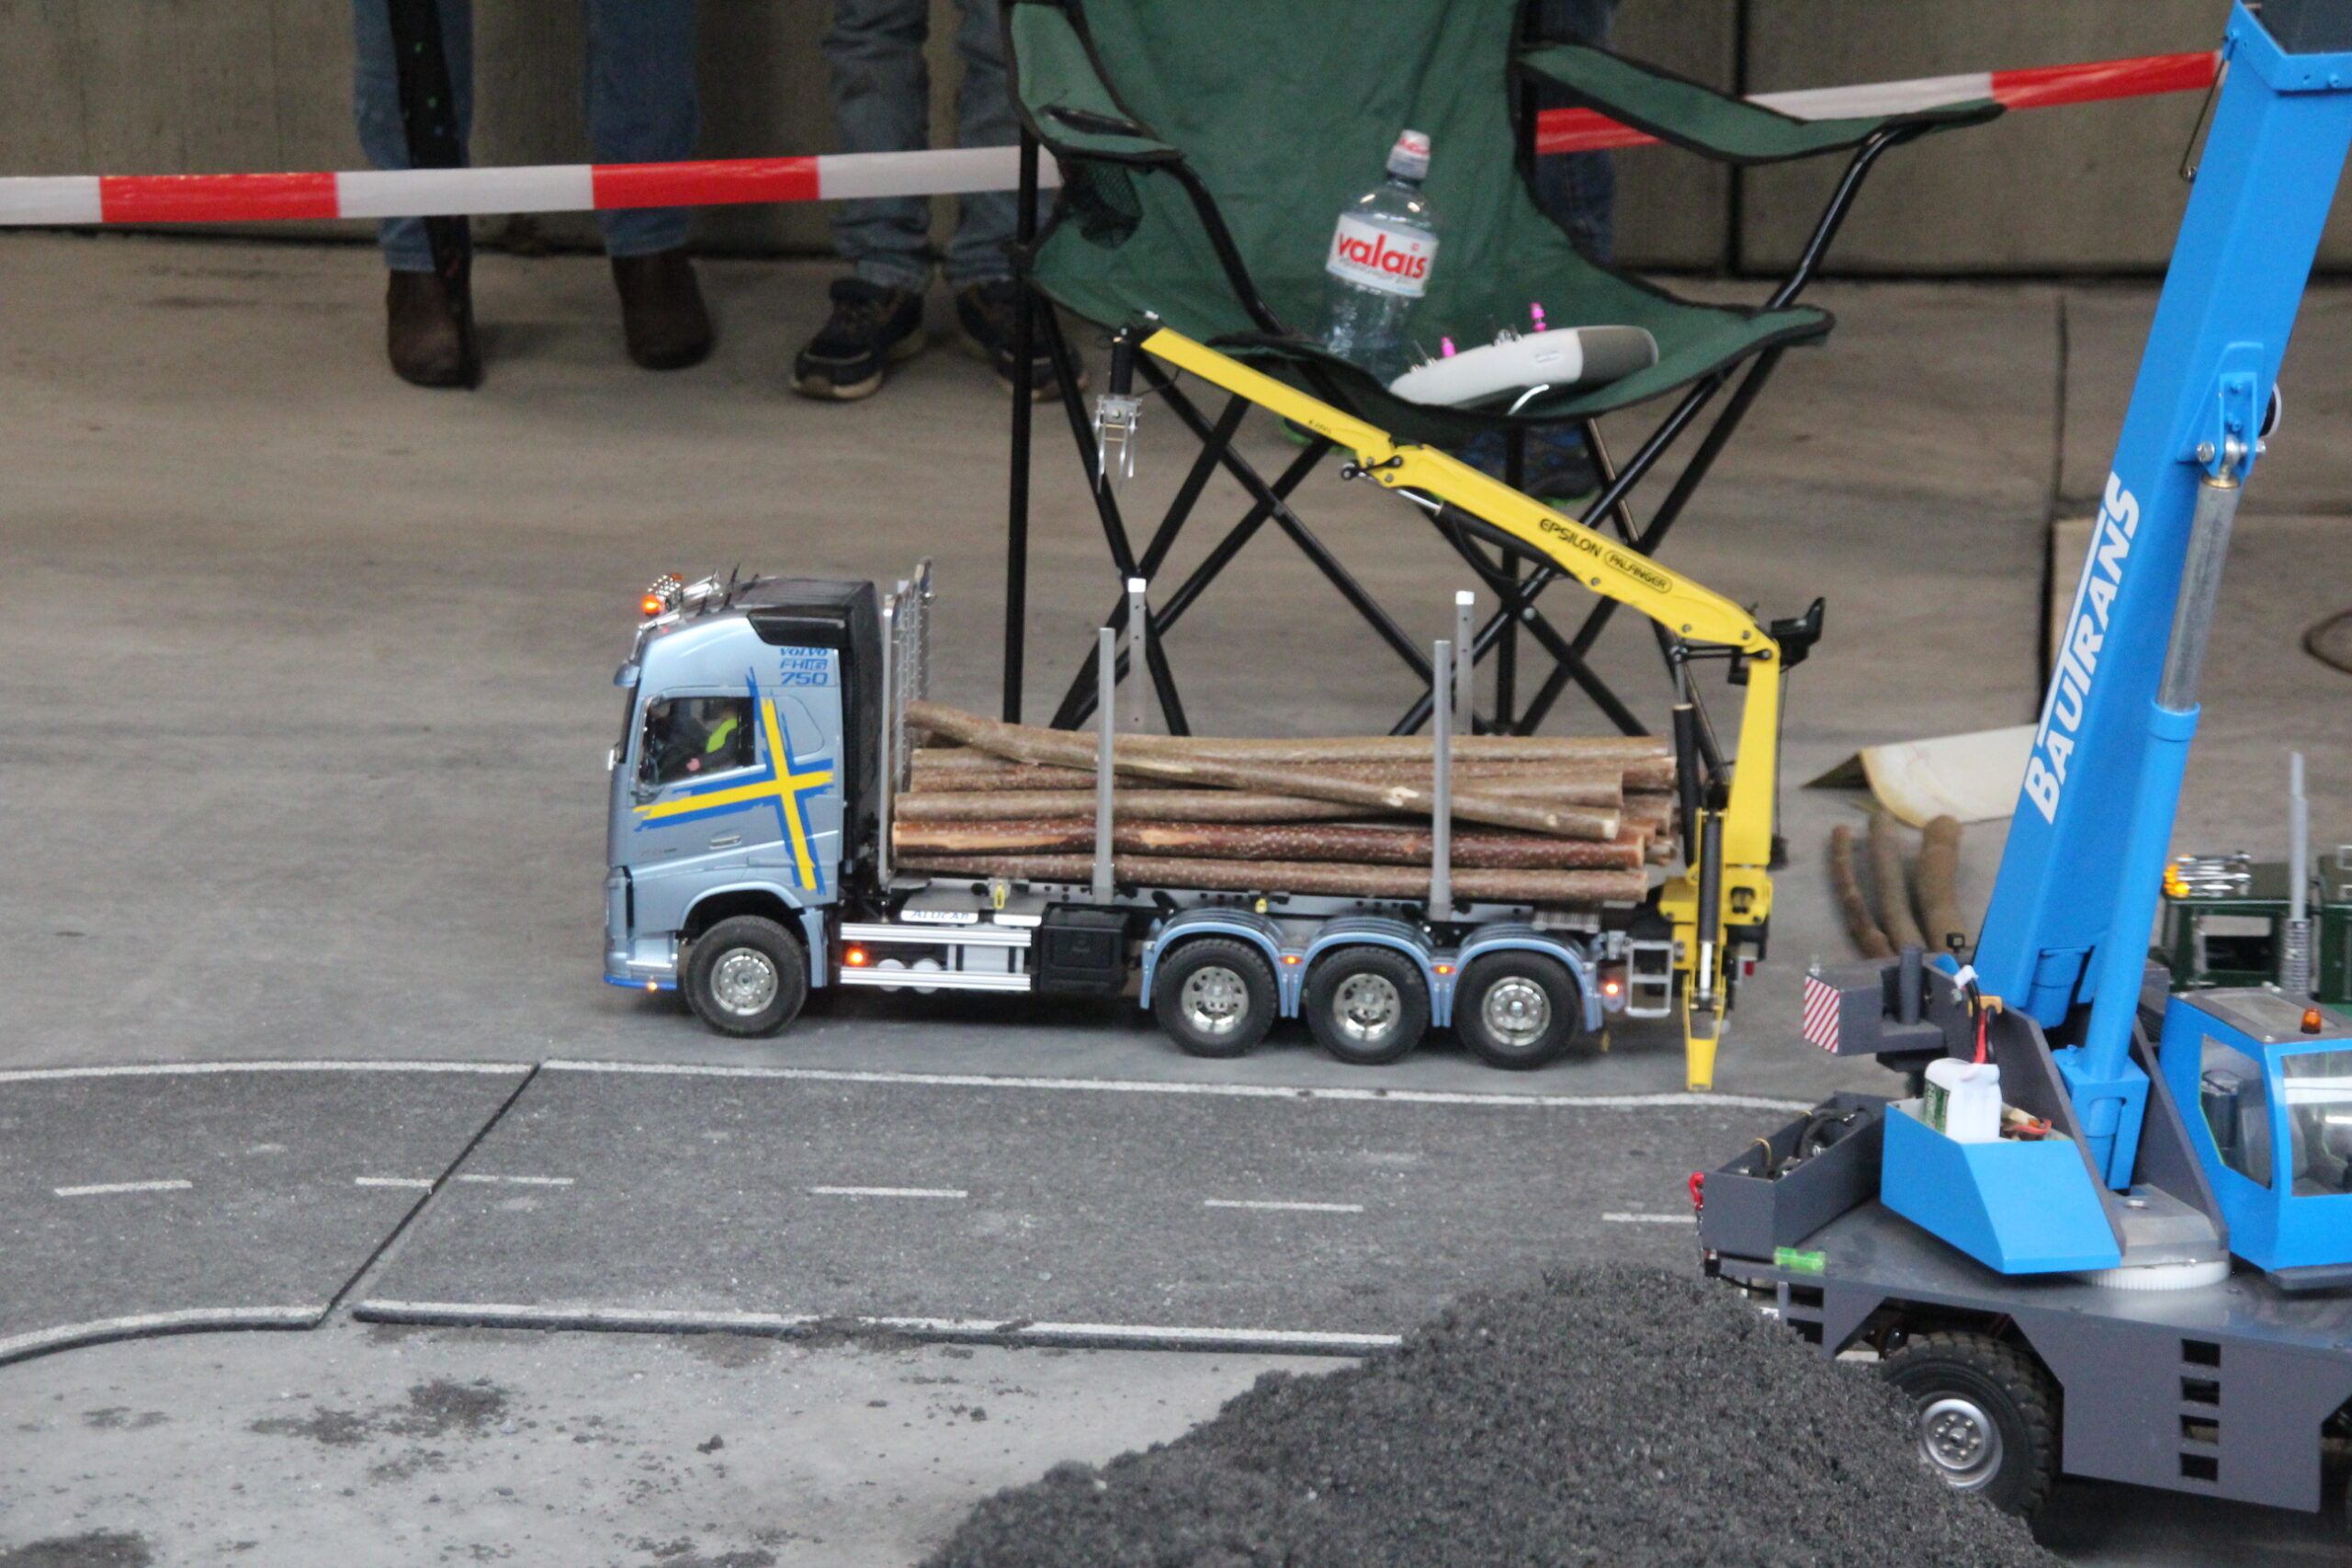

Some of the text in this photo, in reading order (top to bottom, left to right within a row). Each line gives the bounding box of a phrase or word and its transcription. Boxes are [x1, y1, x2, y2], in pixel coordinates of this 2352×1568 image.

[1338, 232, 1427, 278] valais
[1539, 518, 1668, 589] EPSILON PALFINGER
[780, 647, 828, 656] VOLVO
[2024, 471, 2140, 825] BAUTRANS
[780, 671, 828, 685] 750
